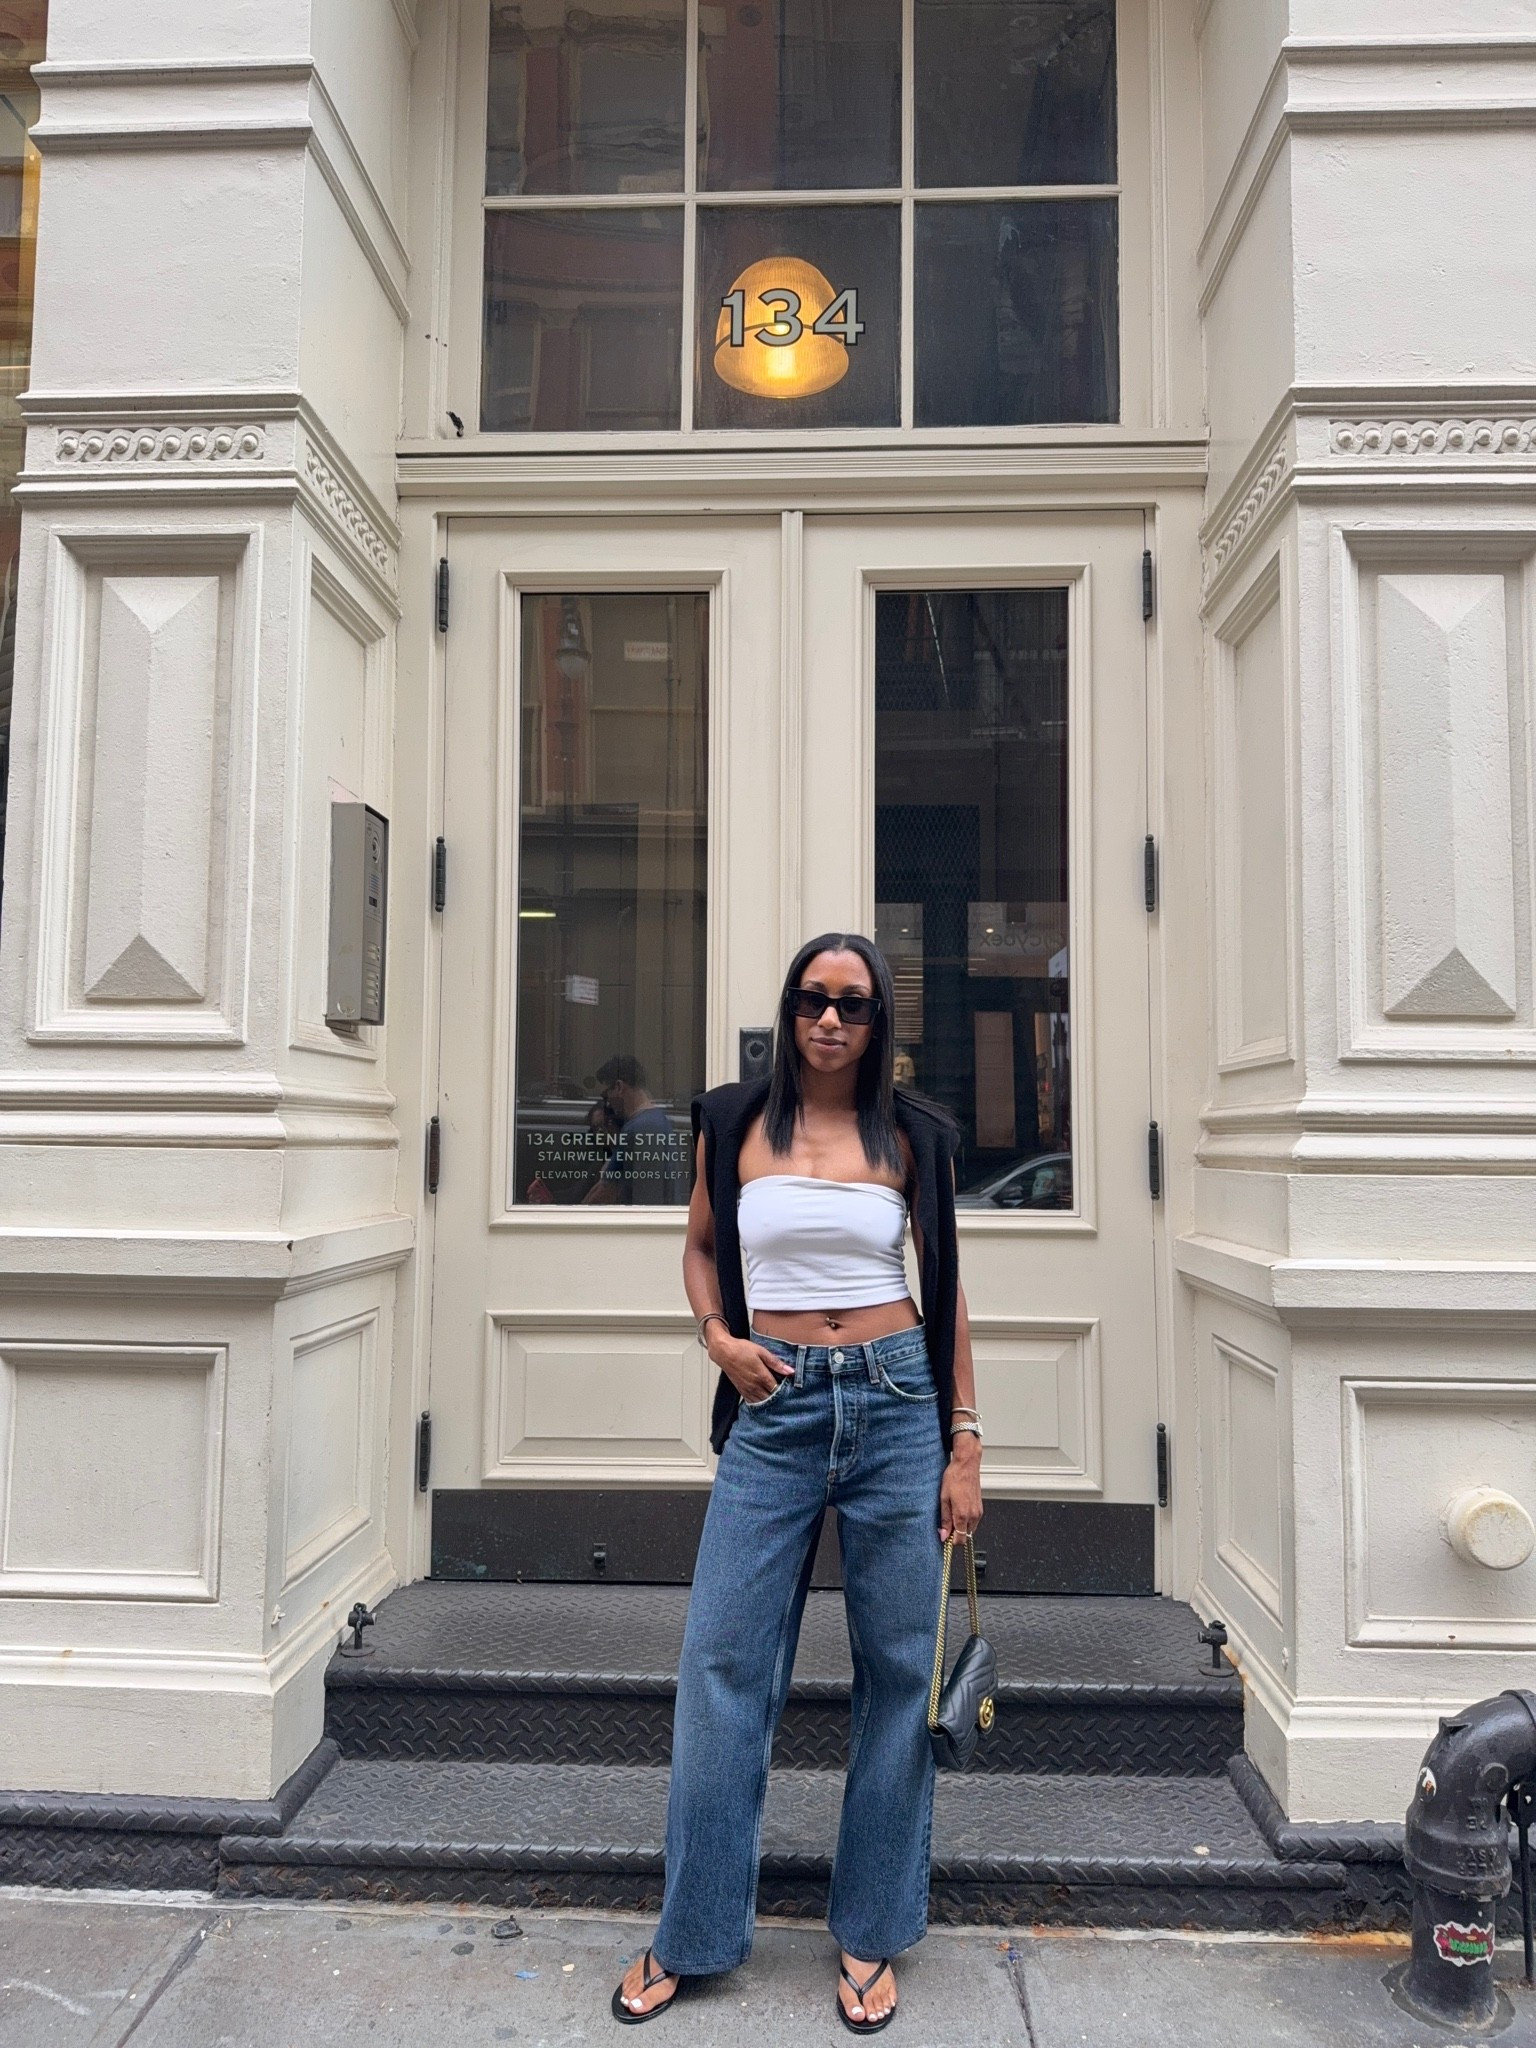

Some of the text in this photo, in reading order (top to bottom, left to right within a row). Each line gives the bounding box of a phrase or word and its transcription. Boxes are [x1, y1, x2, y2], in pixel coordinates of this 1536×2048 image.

[721, 287, 866, 347] 134
[527, 1133, 693, 1146] 134 GREENE STREE
[538, 1151, 687, 1162] STAIRWELL ENTRANCE
[535, 1170, 588, 1179] ELEVATOR
[599, 1170, 621, 1179] TWO
[624, 1170, 661, 1179] DOORS
[664, 1170, 690, 1179] LEFT
